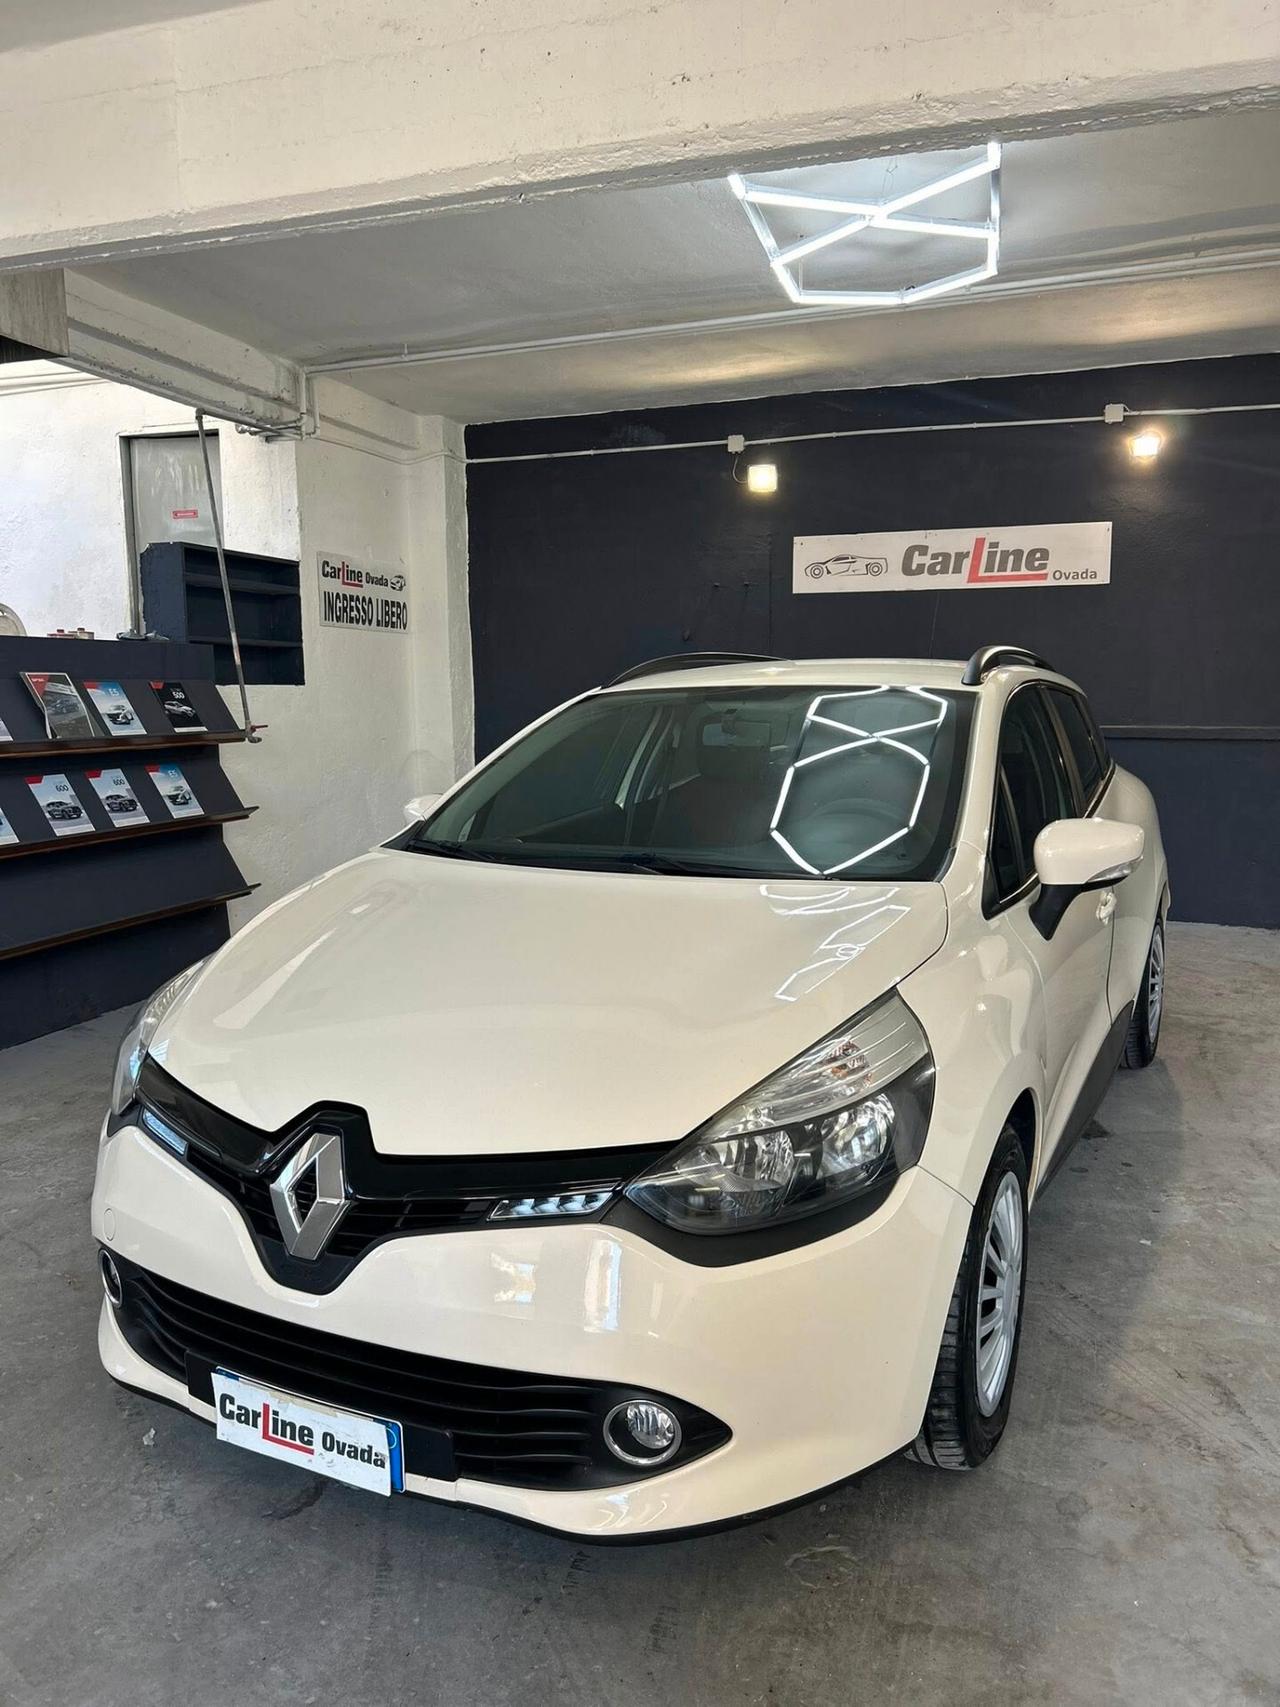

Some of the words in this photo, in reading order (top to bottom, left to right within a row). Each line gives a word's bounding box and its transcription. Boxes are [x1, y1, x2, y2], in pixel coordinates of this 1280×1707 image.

[321, 560, 363, 588] CarLine
[365, 572, 389, 587] Ovada
[901, 537, 1050, 583] CarLine
[1053, 568, 1098, 581] Ovada
[323, 591, 374, 626] INGRESSO
[376, 598, 408, 630] LIBERO
[219, 1393, 315, 1455] CarLine
[321, 1431, 386, 1469] Ovada
